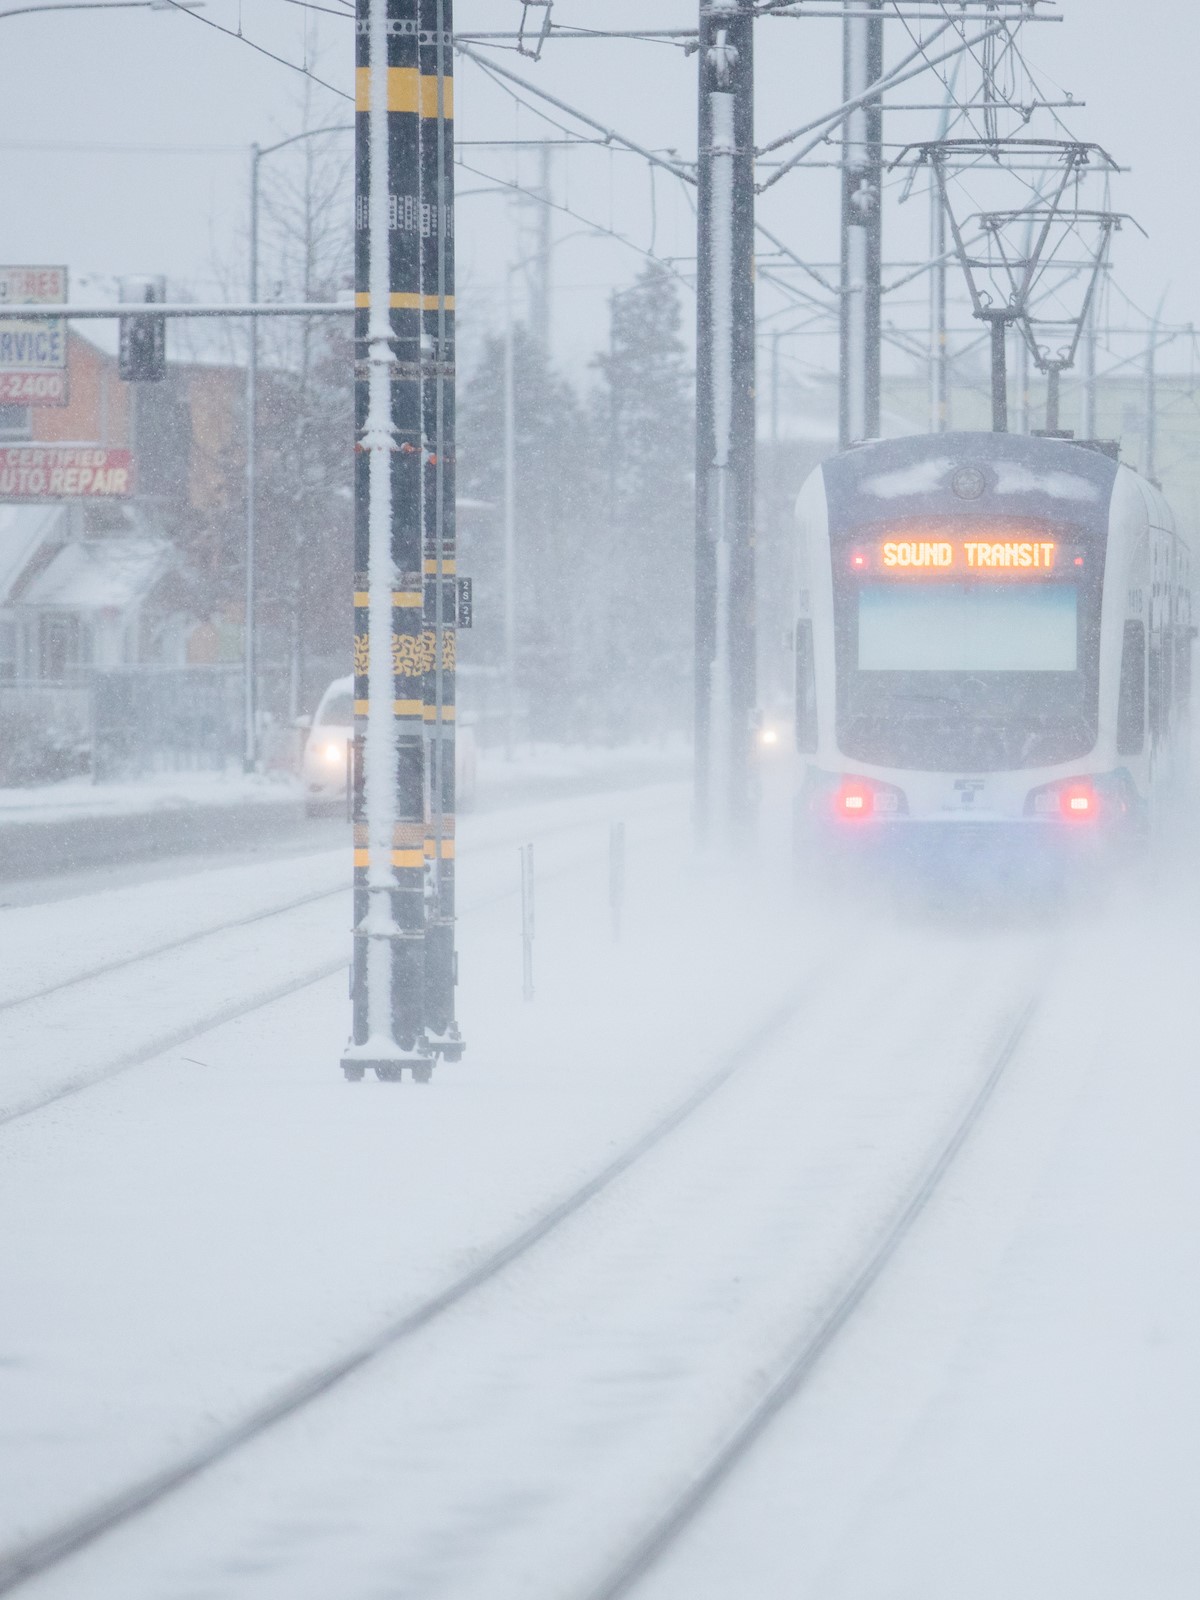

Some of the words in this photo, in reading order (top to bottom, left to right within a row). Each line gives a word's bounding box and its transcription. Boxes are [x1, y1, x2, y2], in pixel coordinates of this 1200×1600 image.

[6, 449, 107, 467] CERTIFIED
[50, 467, 129, 493] REPAIR
[883, 542, 953, 567] SOUND
[964, 542, 1055, 567] TRANSIT
